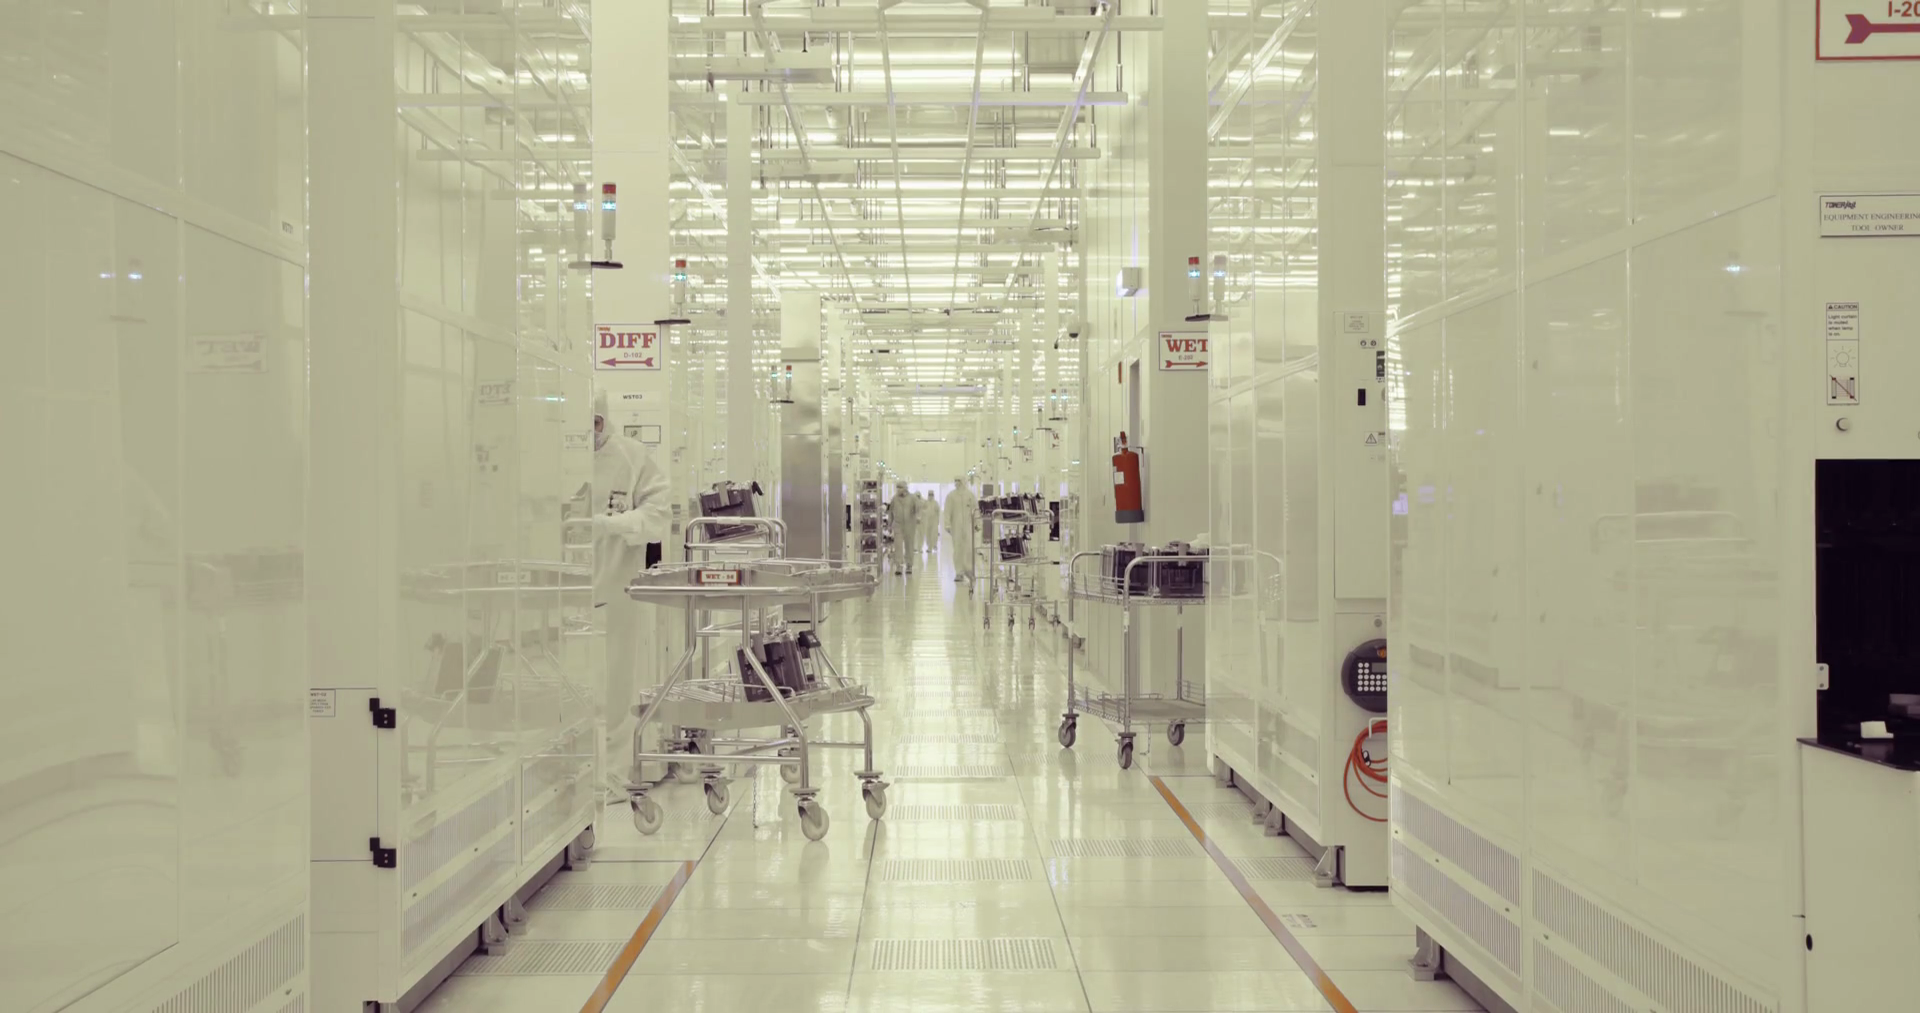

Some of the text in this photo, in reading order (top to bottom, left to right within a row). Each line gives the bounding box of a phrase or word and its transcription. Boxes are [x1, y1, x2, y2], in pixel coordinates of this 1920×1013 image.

[1823, 213, 1868, 221] EQUIPMENT
[599, 332, 656, 349] DIFF
[1165, 338, 1208, 353] WET
